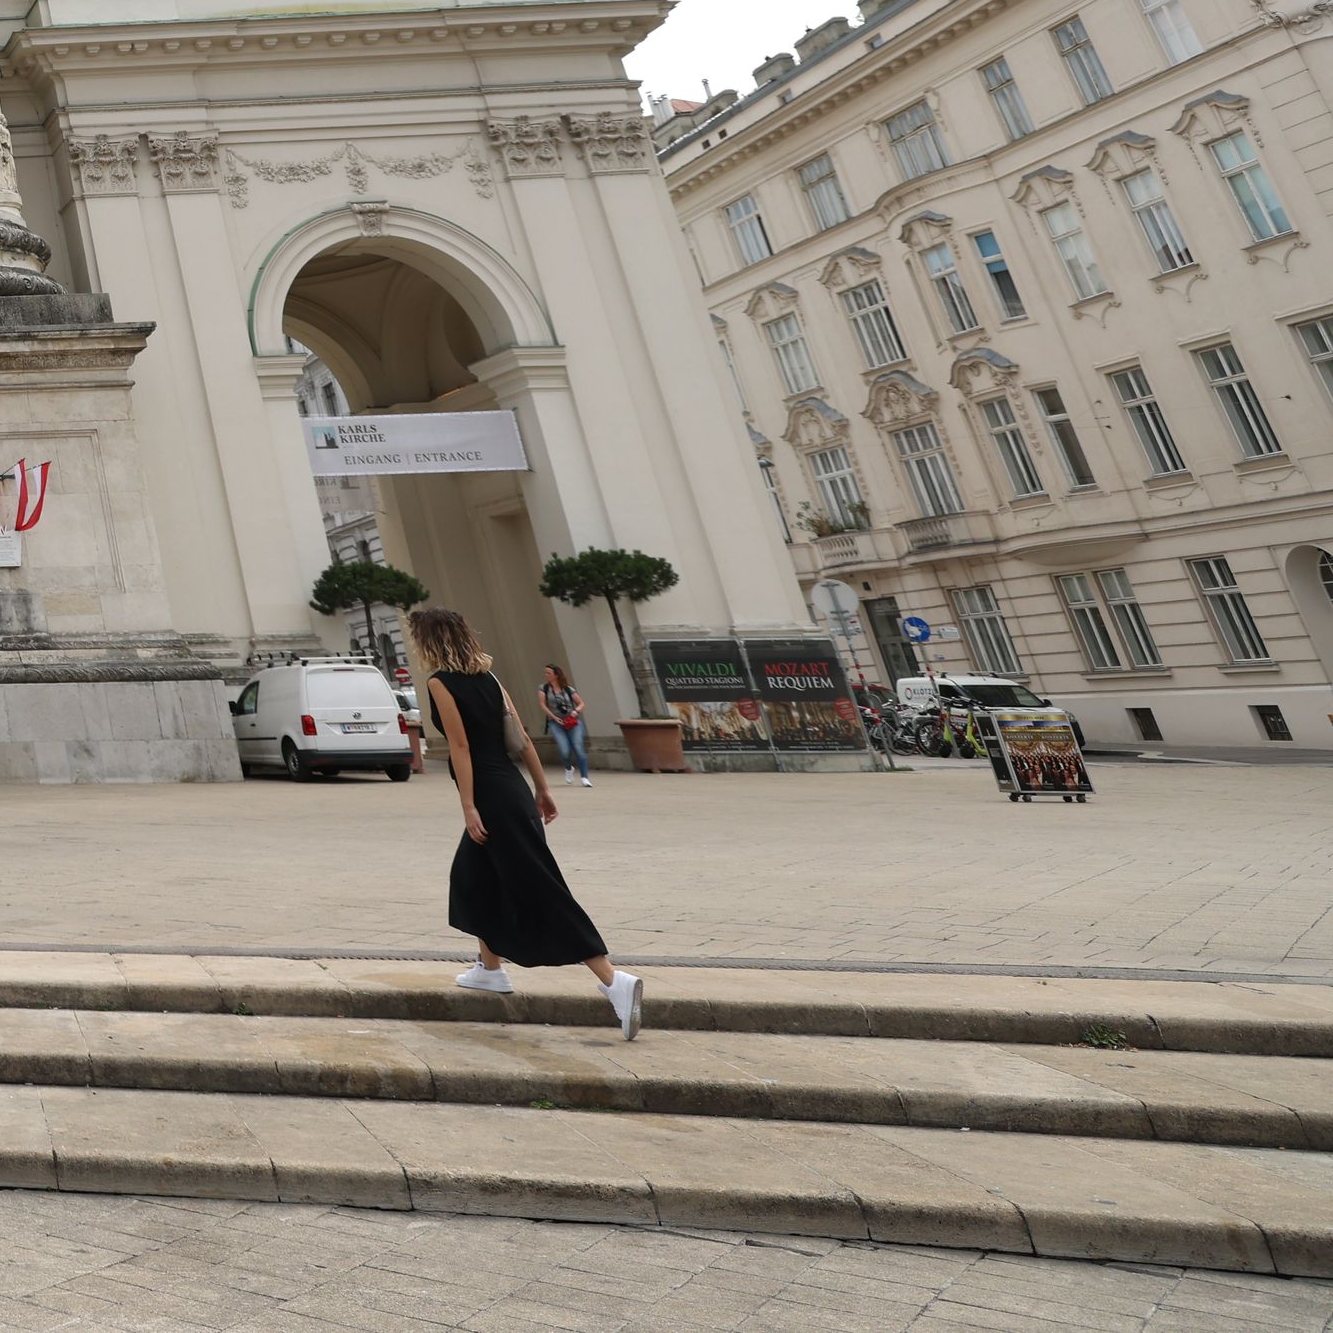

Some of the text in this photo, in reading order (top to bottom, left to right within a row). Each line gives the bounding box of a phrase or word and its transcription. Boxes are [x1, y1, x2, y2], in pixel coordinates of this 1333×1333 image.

[338, 425, 377, 434] KARLS
[340, 433, 386, 444] KIRCHE
[344, 451, 483, 465] EINGANG ENTRANCE
[667, 663, 736, 676] VIVALDI
[764, 662, 829, 675] MOZART
[665, 676, 745, 685] QUATTRO STAGIONI
[767, 676, 834, 691] REQUIEM
